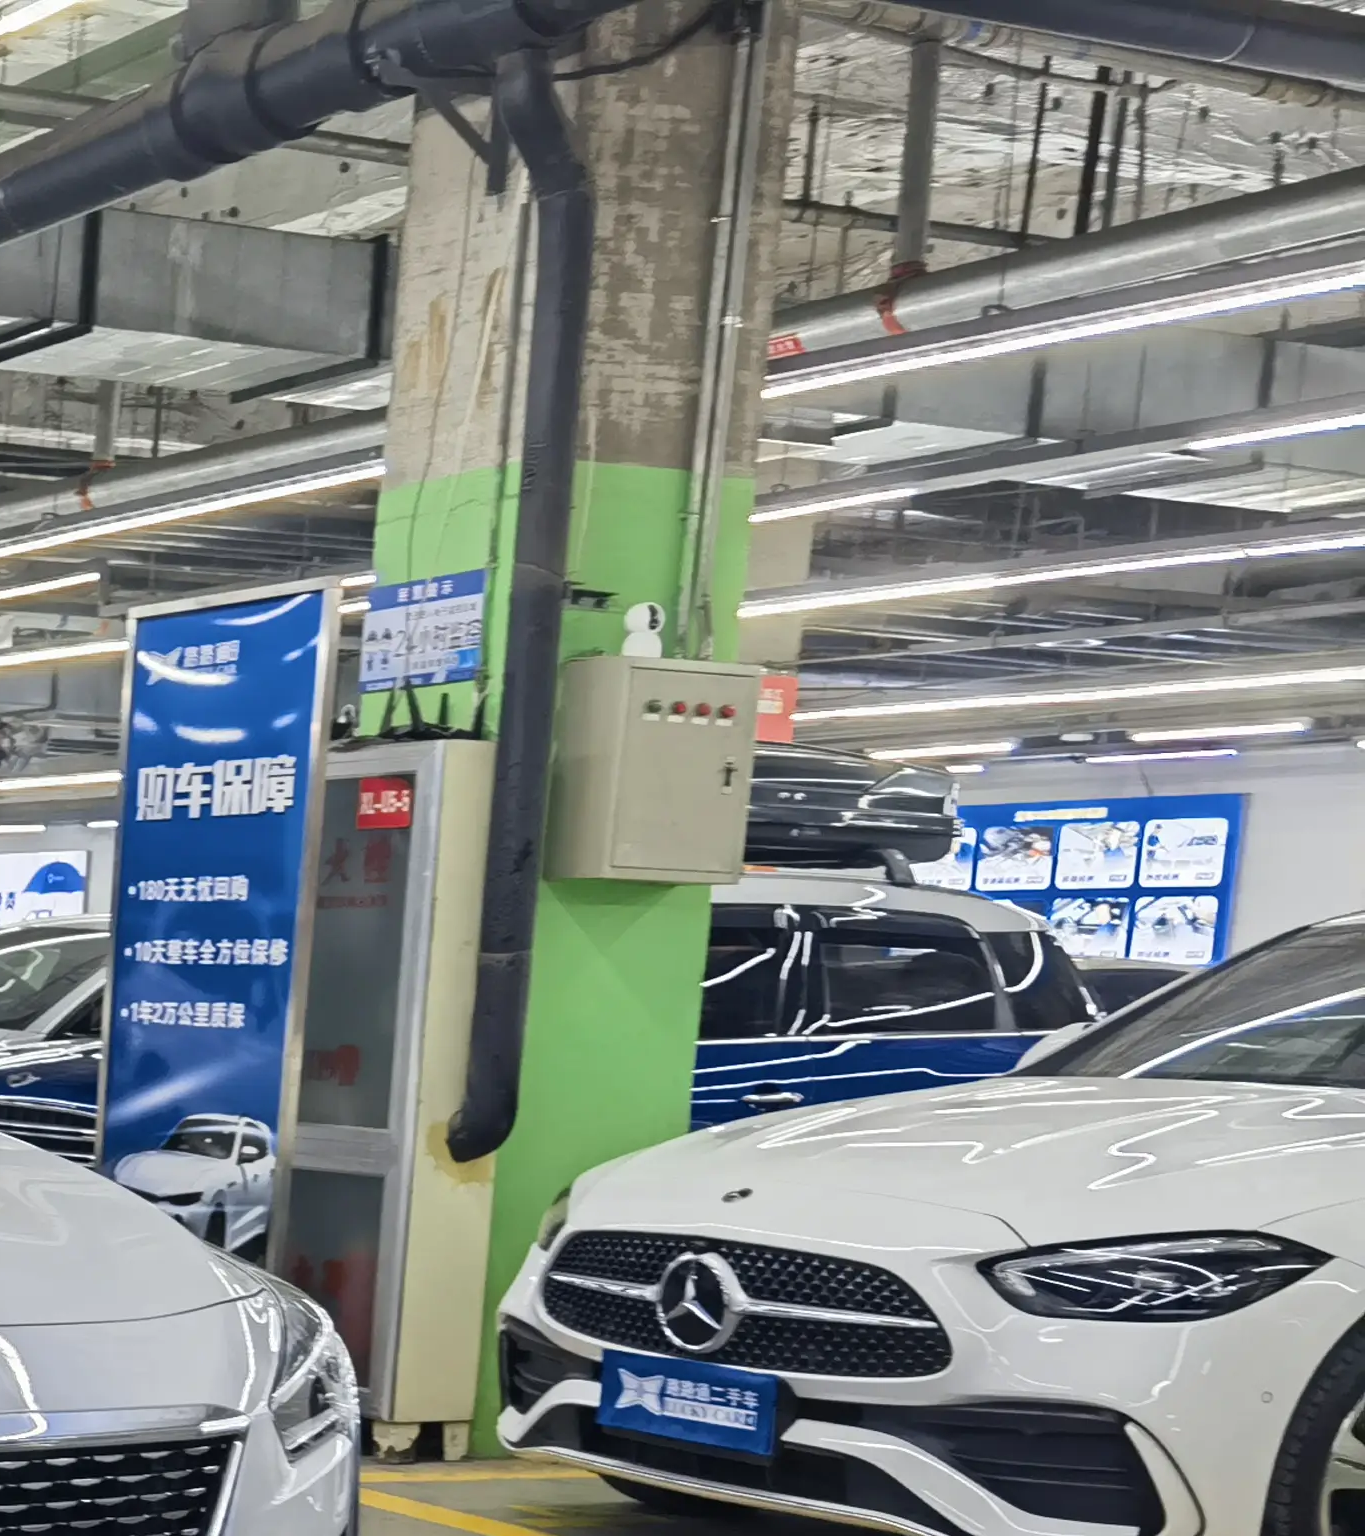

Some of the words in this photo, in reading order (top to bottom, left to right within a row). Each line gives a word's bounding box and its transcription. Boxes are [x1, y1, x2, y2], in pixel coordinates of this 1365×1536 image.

[136, 754, 297, 821] 购车保障
[130, 1000, 246, 1028] 1年2万公里质保
